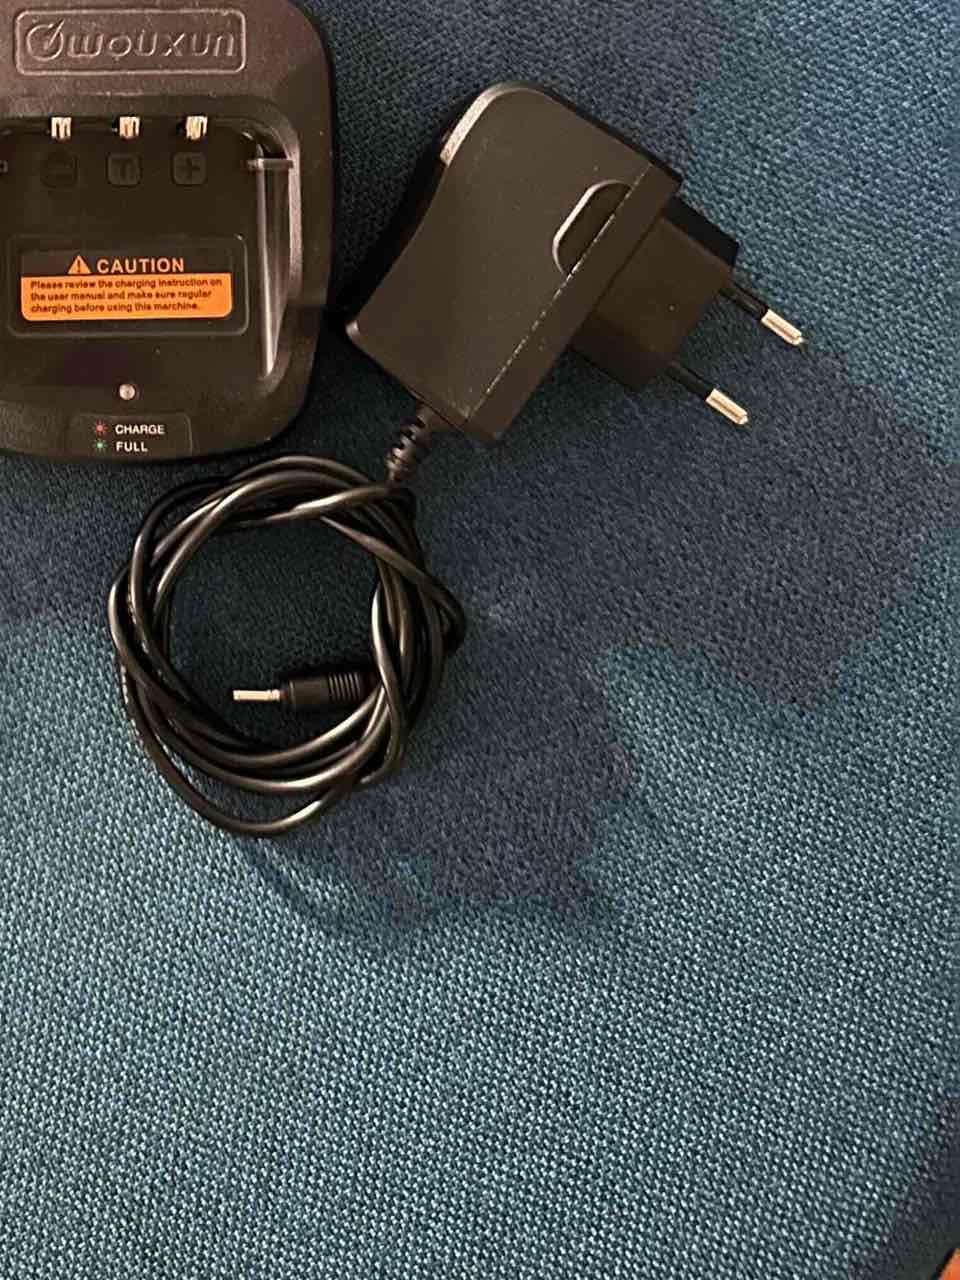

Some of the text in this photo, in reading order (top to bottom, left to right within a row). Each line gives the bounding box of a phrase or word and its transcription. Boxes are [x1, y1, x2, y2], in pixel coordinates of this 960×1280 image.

[97, 258, 184, 273] CAUTION
[30, 281, 62, 289] Please
[98, 280, 112, 288] the
[115, 280, 156, 289] charging
[158, 278, 208, 287] instruction
[31, 293, 46, 301] the
[128, 291, 153, 299] make
[178, 290, 211, 299] regular
[31, 304, 72, 314] charging
[74, 304, 104, 312] before
[107, 304, 132, 313] using
[135, 303, 151, 311] this
[115, 425, 165, 434] CHARGE
[116, 441, 148, 452] FULL
